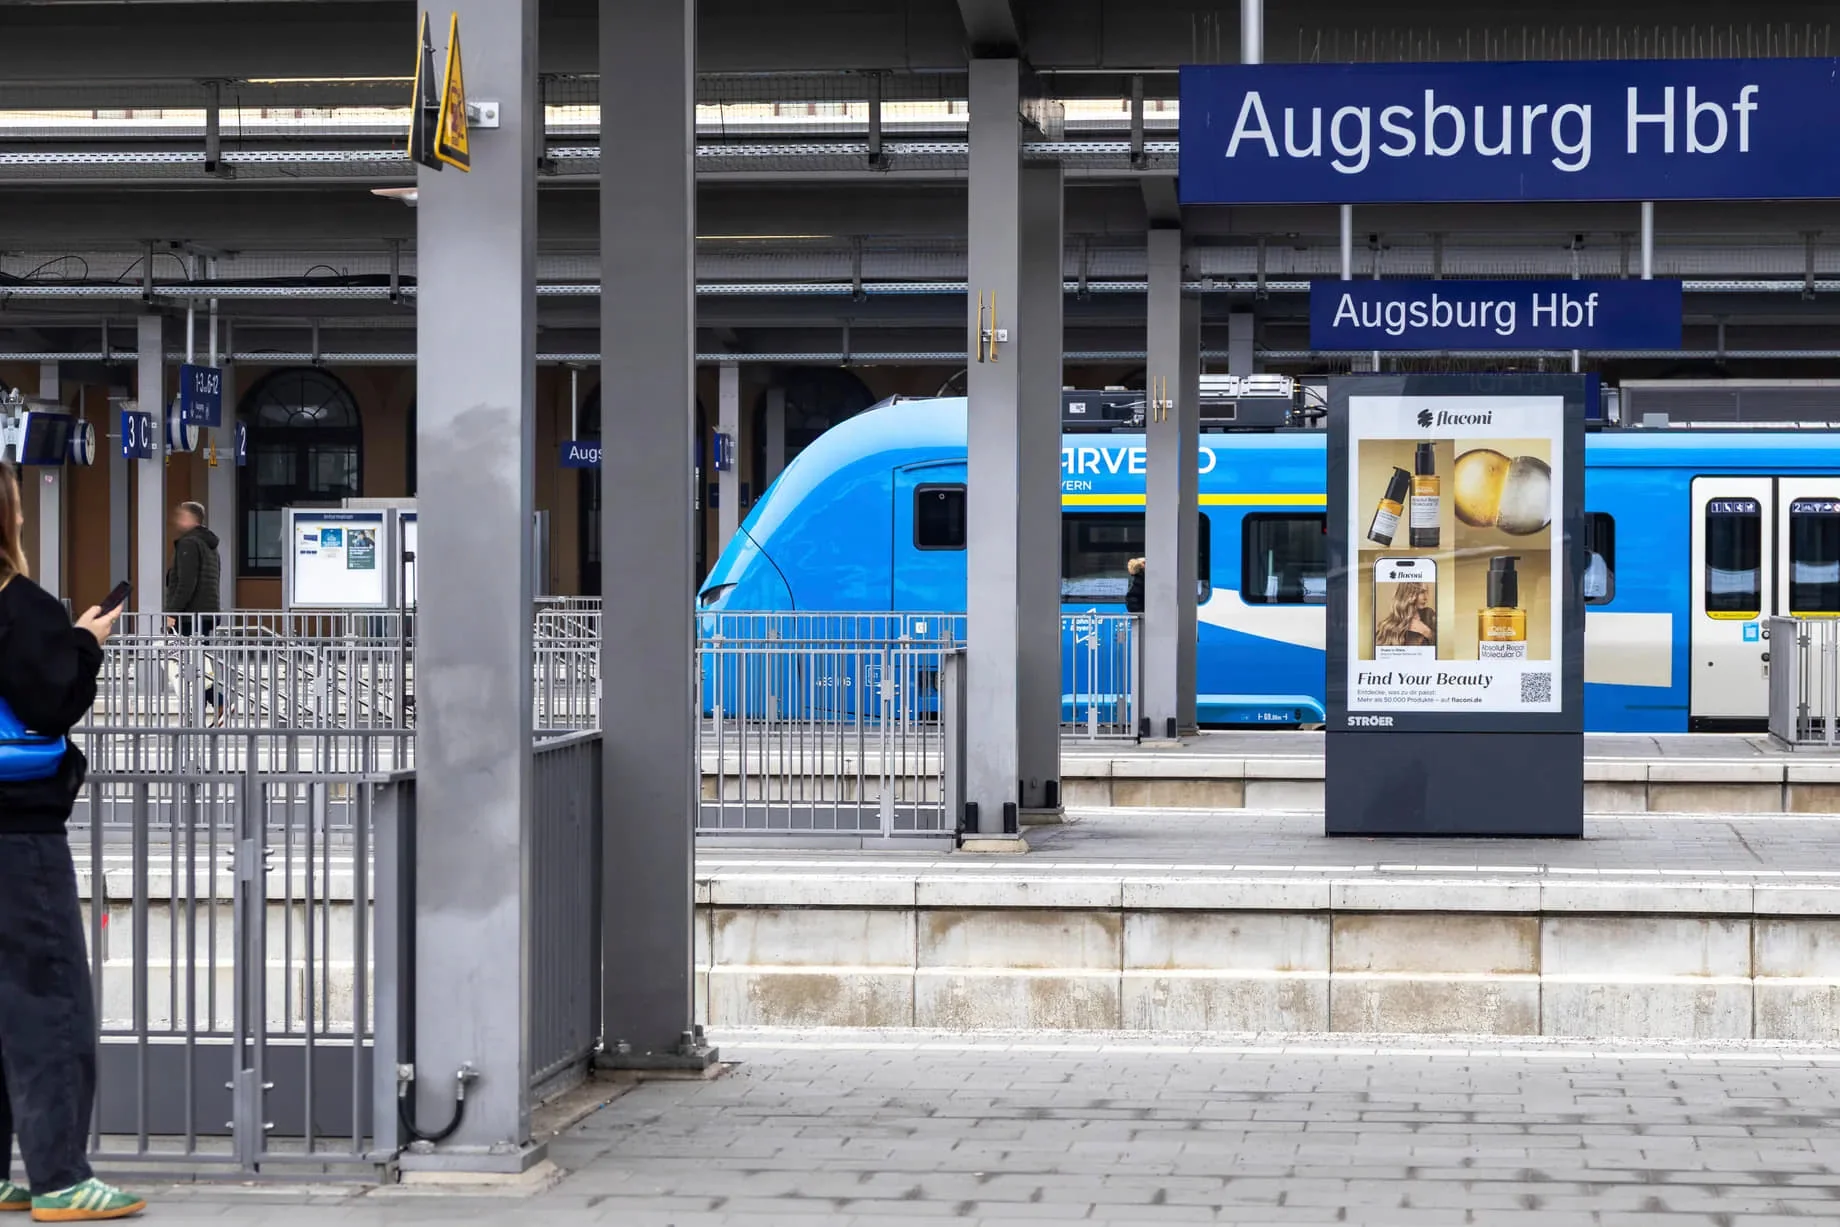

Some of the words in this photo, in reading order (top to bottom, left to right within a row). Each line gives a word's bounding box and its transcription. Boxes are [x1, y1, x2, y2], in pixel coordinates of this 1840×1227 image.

[1225, 89, 1592, 174] Augsburg
[1627, 84, 1759, 154] Hbf
[1332, 293, 1516, 336] Augsburg
[1532, 292, 1599, 328] Hbf
[1436, 410, 1492, 427] flaconi
[128, 415, 136, 448] 3
[141, 416, 148, 448] C
[240, 426, 246, 456] 2
[569, 445, 603, 463] Augs
[1357, 671, 1393, 686] Find
[1398, 672, 1433, 686] Your
[1436, 672, 1493, 689] Beauty
[1347, 715, 1394, 727] STRÖER
